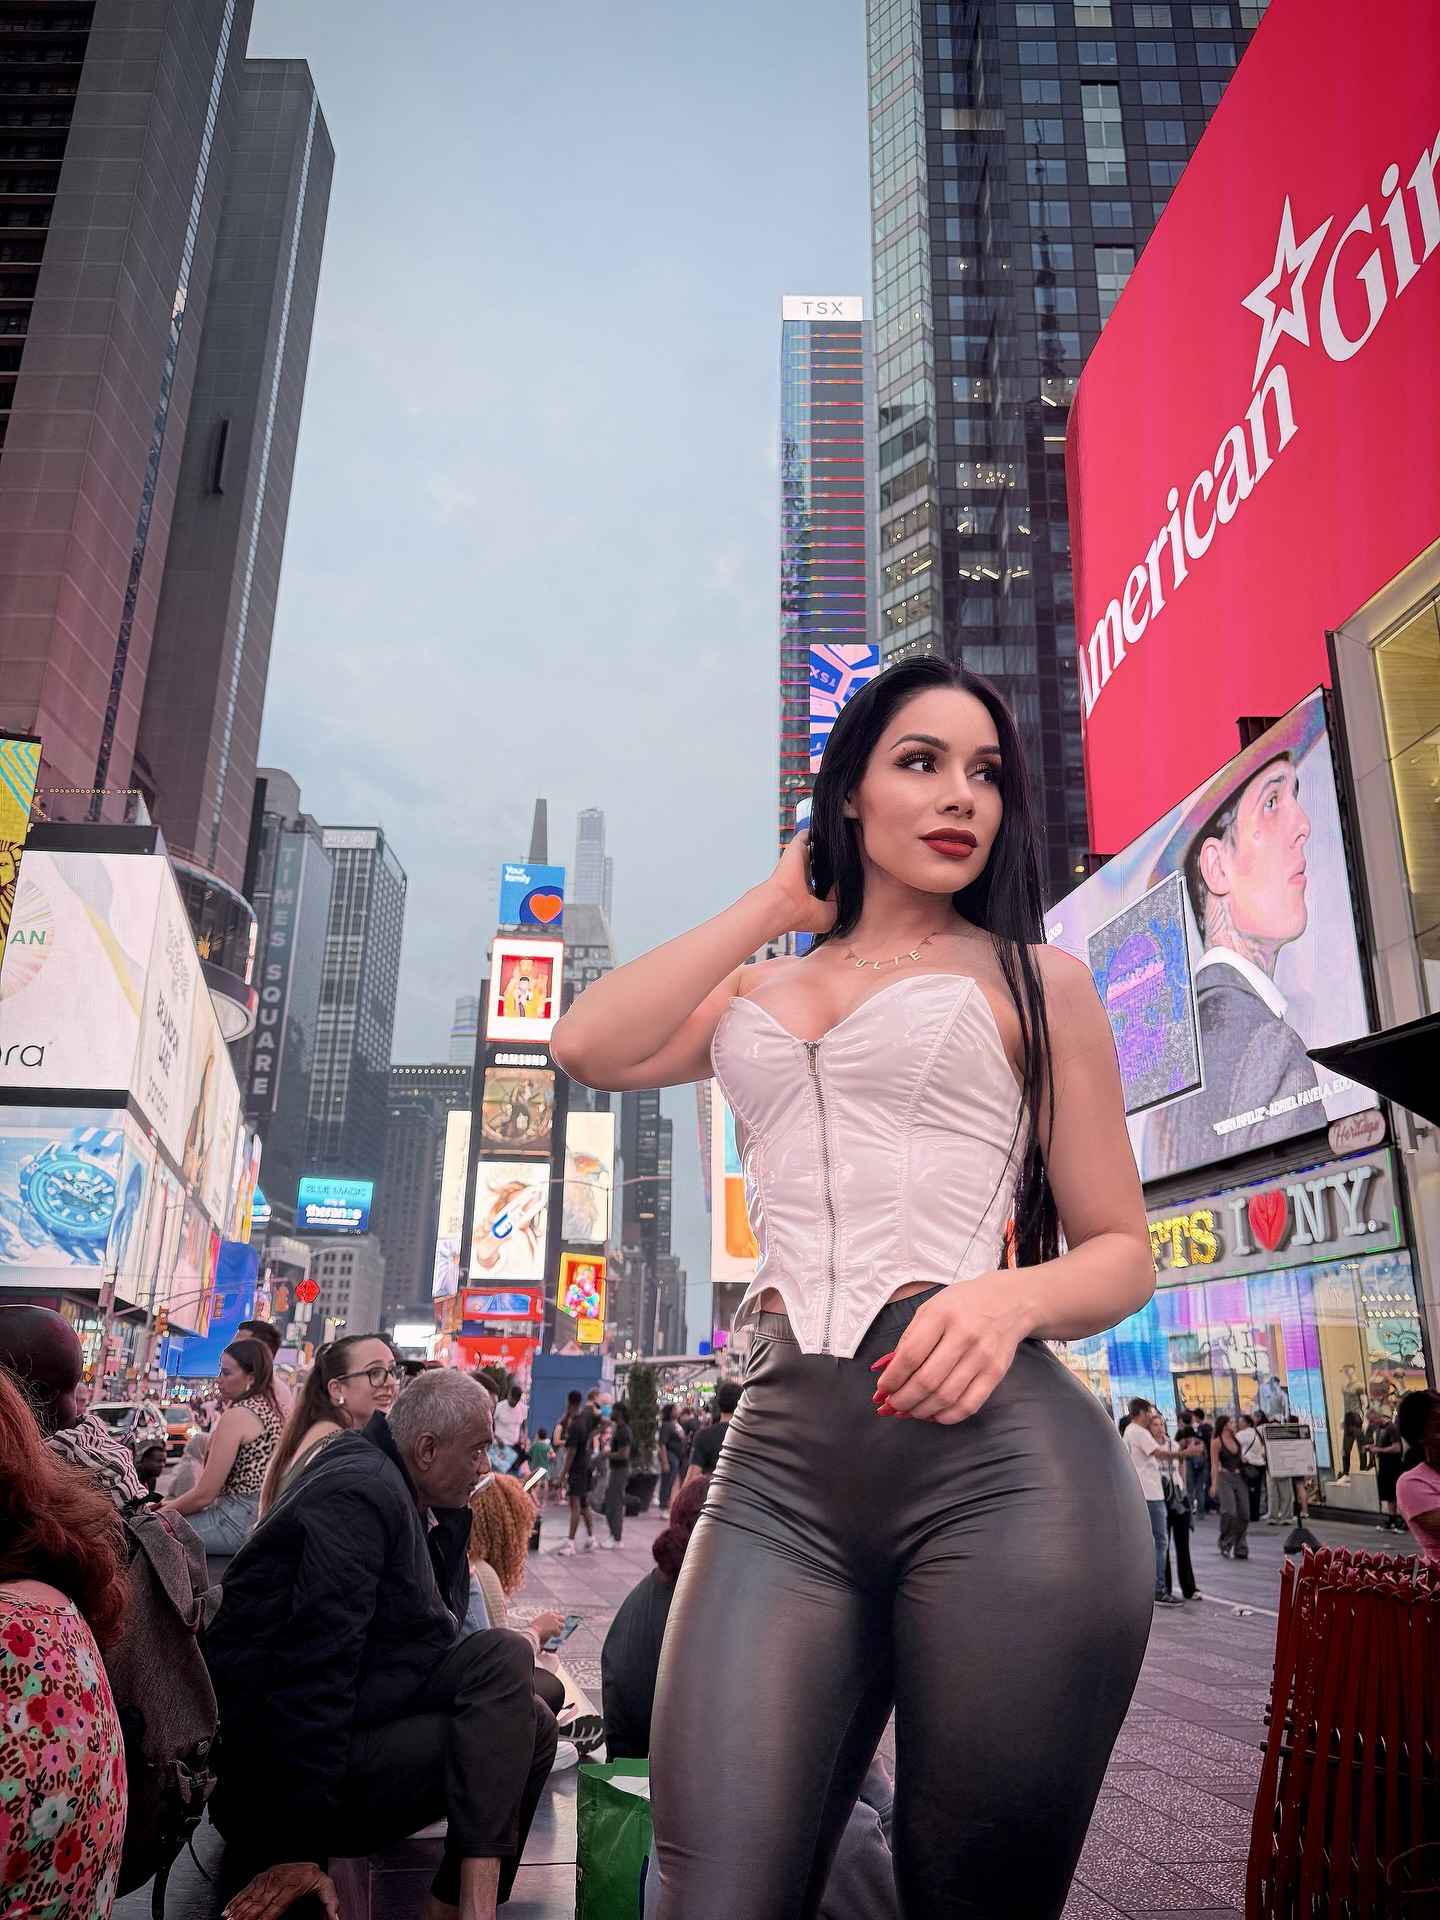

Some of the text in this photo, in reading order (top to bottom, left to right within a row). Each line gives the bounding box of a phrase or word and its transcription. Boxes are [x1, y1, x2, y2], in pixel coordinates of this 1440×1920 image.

[801, 301, 843, 315] TSX
[10, 930, 47, 945] AN
[252, 847, 297, 1095] TIMES SQUARE
[0, 1044, 45, 1067] ra
[1227, 1197, 1250, 1256] I
